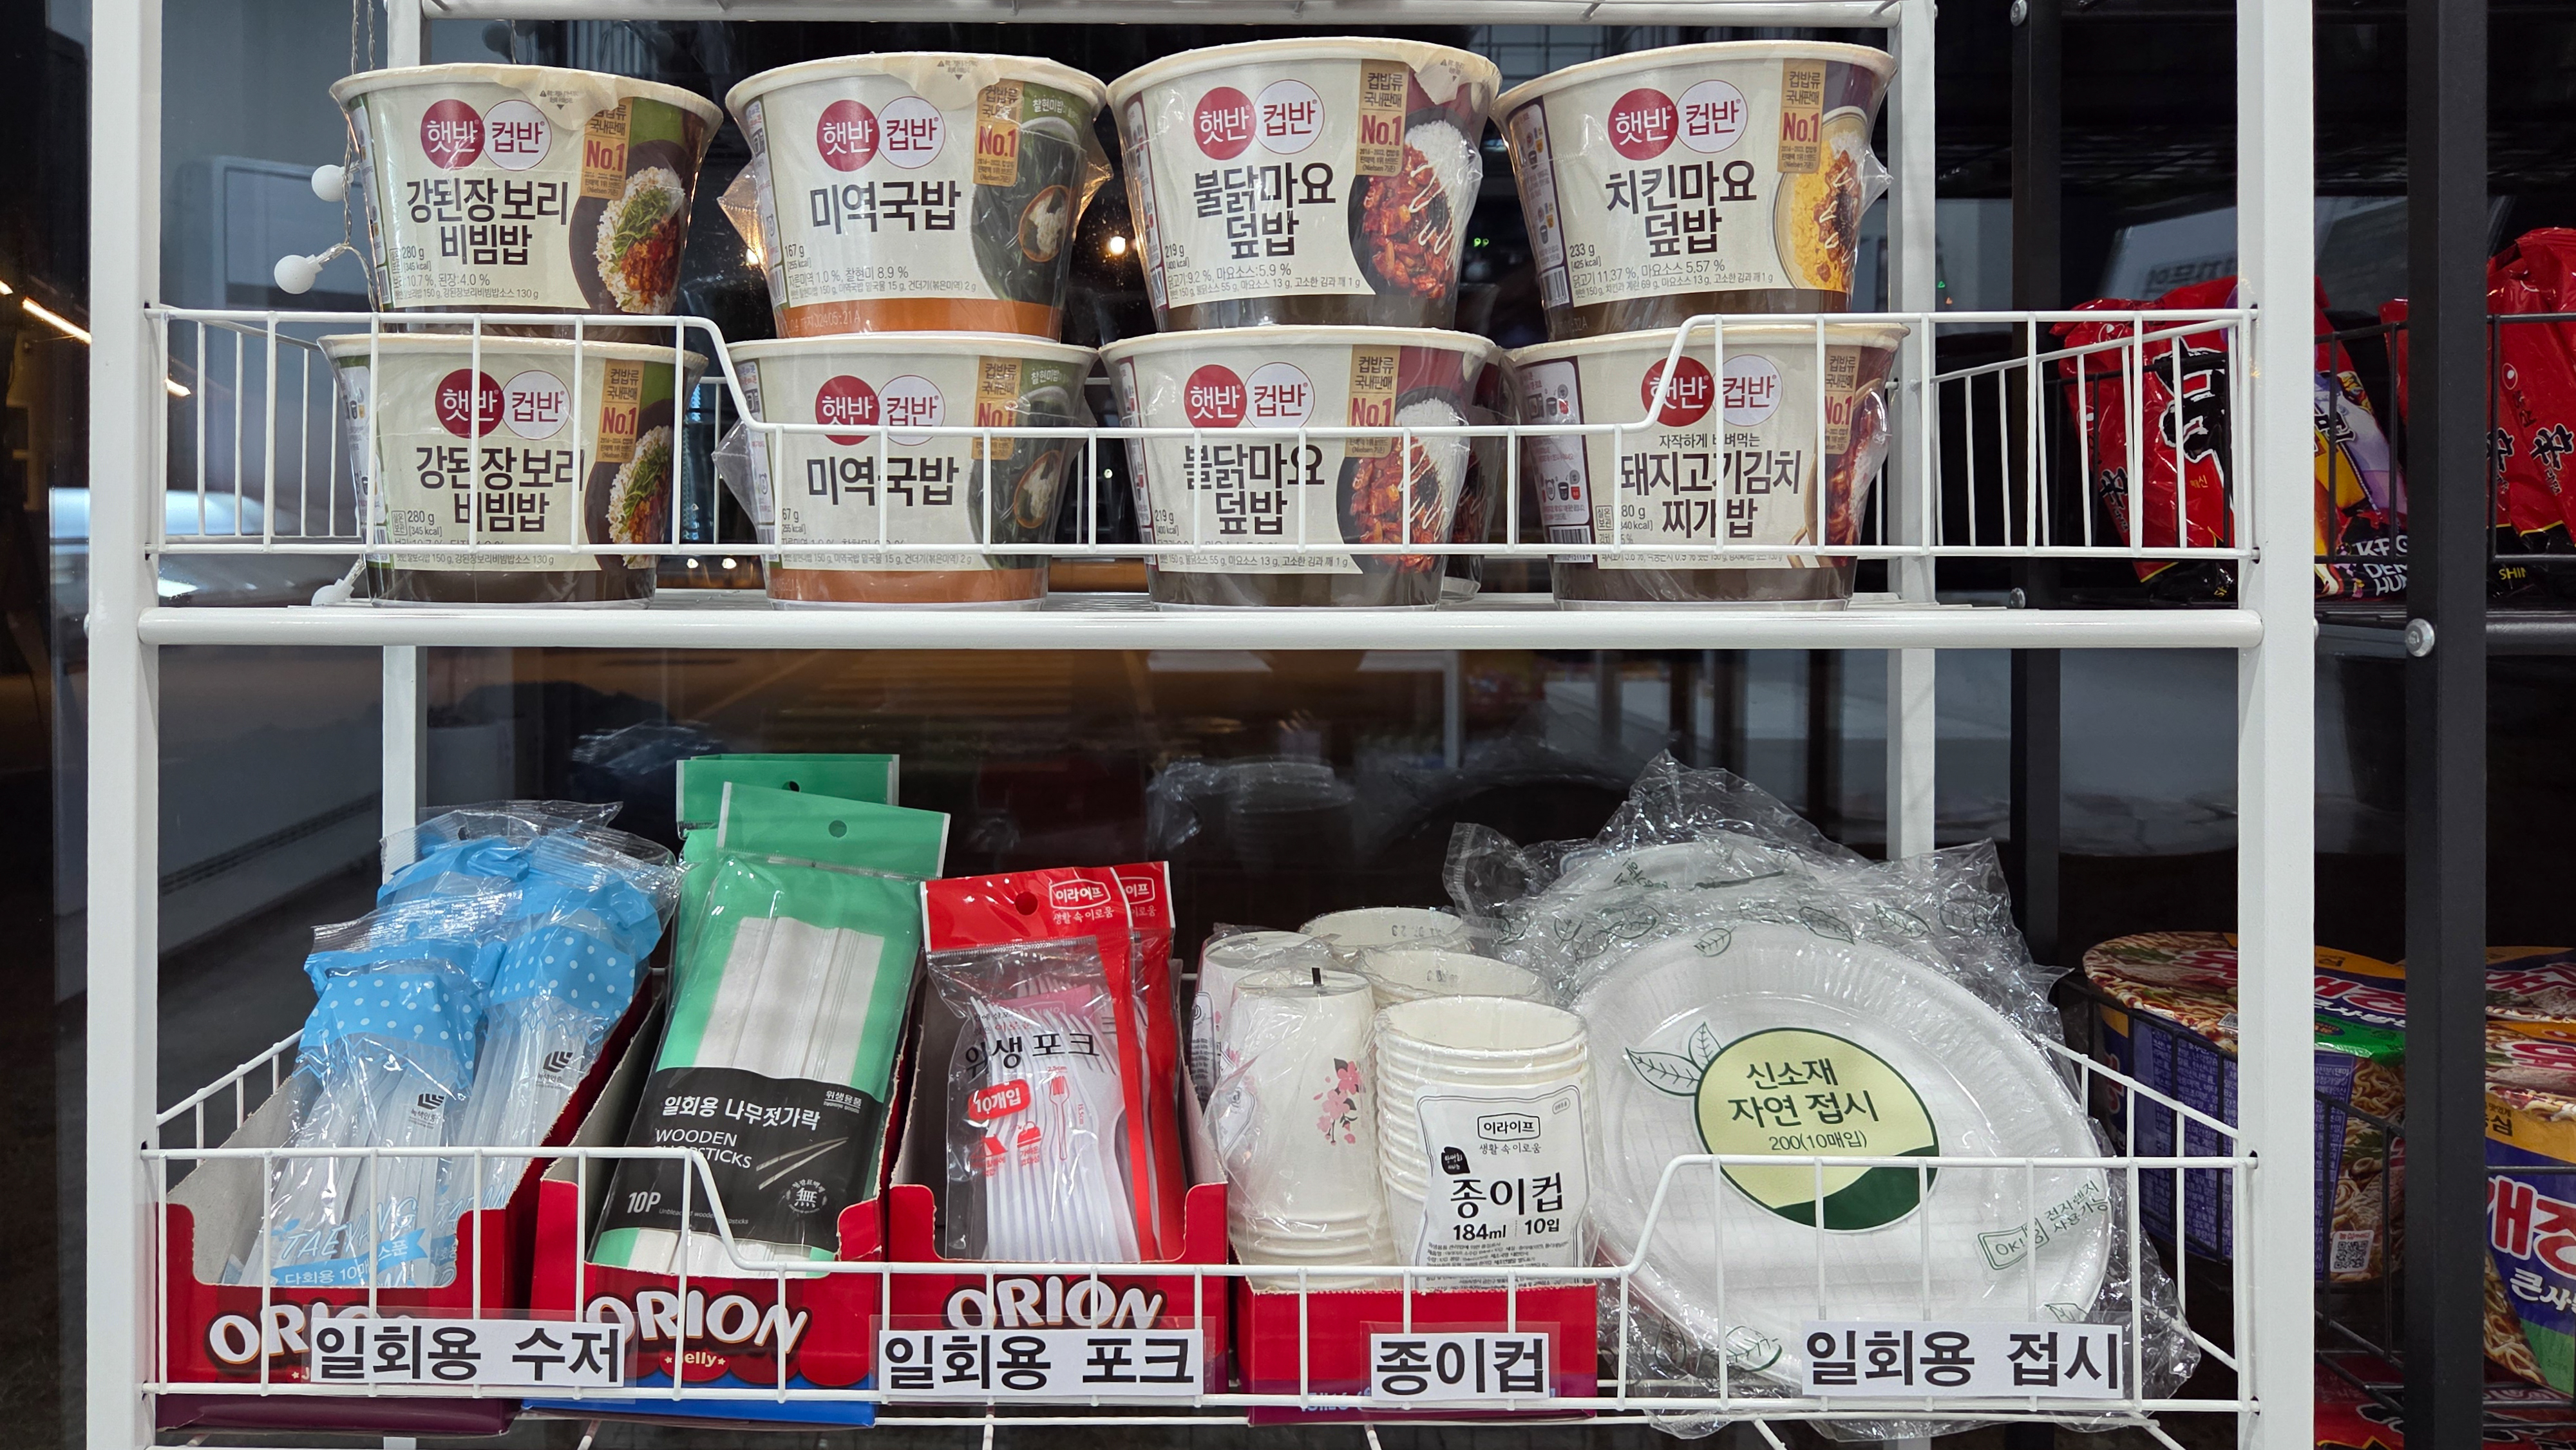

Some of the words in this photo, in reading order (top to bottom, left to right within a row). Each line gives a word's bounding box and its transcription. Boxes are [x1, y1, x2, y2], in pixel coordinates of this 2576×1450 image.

[1367, 73, 1403, 91] 컵밥류
[1789, 71, 1821, 89] 컵밥류
[1364, 91, 1402, 108] 국내판매
[1786, 90, 1819, 106] 국내판매
[589, 118, 626, 137] 국내판매
[1199, 110, 1249, 146] 햇반
[1264, 100, 1316, 137] 컵반
[1361, 115, 1402, 146] No.1
[1615, 109, 1671, 146] 햇반
[1685, 99, 1739, 137] 컵반
[1783, 112, 1819, 142] No.1
[426, 120, 476, 154] 햇반
[491, 122, 542, 153] 컵반
[823, 120, 873, 155] 햇반
[886, 118, 937, 152] 컵반
[978, 126, 1017, 158] No.1
[586, 140, 625, 172] No.1
[1194, 162, 1336, 219] 불닭마요
[1605, 160, 1757, 214] 치킨마요
[810, 180, 961, 234] 미역국밥
[1226, 211, 1300, 259] 덮밥
[1645, 208, 1722, 258] 덮밥
[402, 246, 417, 259] 280
[442, 225, 533, 265] 비빔밥
[784, 244, 797, 258] 167
[1165, 245, 1178, 258] 219
[1569, 244, 1587, 258] 233
[416, 260, 431, 272] kcal]
[815, 271, 829, 284] 1.0
[845, 267, 875, 283] 찰현미
[877, 267, 895, 279] 8.9
[1217, 264, 1276, 280] 마요소스:5.9
[1571, 260, 1584, 272] [425
[1585, 258, 1602, 268] kcal]
[1598, 269, 1623, 283] 11.37
[1642, 263, 1683, 278] 마요소스
[1686, 260, 1710, 274] 5.57
[438, 274, 477, 286] 된장:4.0
[887, 281, 898, 290] 15
[1221, 282, 1231, 292] 55
[1241, 280, 1270, 289] 마요소스
[1273, 279, 1283, 288] 13
[1294, 277, 1318, 287] 고소한
[1642, 279, 1651, 290] 69
[1662, 276, 1691, 288] 마요소스
[1693, 275, 1703, 285] 13
[1714, 274, 1736, 284] 고소한
[444, 288, 515, 299] 강된장보리비빔밥소스
[516, 289, 531, 298] 130
[985, 363, 1016, 380] 컵밥류
[1359, 356, 1394, 374] 컵밥류
[1830, 355, 1855, 373] 컵밥류
[610, 369, 639, 386] 컵밥류
[1355, 375, 1392, 390] 국내판매
[1825, 374, 1854, 388] 국내판매
[607, 386, 638, 400] 국내판매
[1190, 386, 1238, 419] 햇반
[1255, 384, 1306, 417] 컵반
[1649, 377, 1707, 410] 햇반
[1723, 375, 1774, 409] 컵반
[443, 388, 497, 421] 햇반
[511, 390, 562, 422] 컵반
[822, 395, 873, 425] 햇반
[887, 396, 937, 426] 컵반
[1351, 397, 1392, 426] No.1
[1825, 395, 1852, 425] No.1
[602, 407, 636, 435] No.1
[1659, 433, 1707, 449] 자작하게
[1183, 444, 1325, 491] 불닭마요
[1621, 450, 1802, 496] 돼지고기김치
[807, 456, 960, 506] 미역국밥
[408, 511, 425, 522] 280
[455, 493, 549, 532] 비빔밥
[1155, 509, 1167, 522] 219
[1215, 491, 1288, 534] 덮밥
[408, 527, 423, 537] [345
[424, 526, 442, 537] kcal]
[1633, 520, 1653, 531] kcal]
[432, 554, 446, 563] 150
[455, 554, 530, 564] 강된장보리비빔밥소스
[533, 555, 547, 564] 130
[885, 555, 895, 563] 15
[1210, 556, 1219, 564] 55
[1229, 556, 1257, 566] 마요소스
[1260, 556, 1271, 566] 13
[1282, 556, 1305, 567] 고소한
[1308, 556, 1323, 567] 김과
[1056, 887, 1104, 903] 이라이프
[1053, 910, 1070, 925] 생활
[1074, 910, 1083, 923] 속
[1085, 906, 1115, 921] 이로움
[1032, 1033, 1100, 1056] 포크
[1747, 1058, 1839, 1090] 신소재
[826, 1090, 862, 1107] 위생용품
[974, 1088, 1021, 1113] 10개입
[1728, 1095, 1801, 1128] 자연
[1808, 1089, 1879, 1125] 접시
[662, 1095, 719, 1117] 일회용
[724, 1098, 821, 1131] 나무젓가락
[656, 1128, 738, 1147] WOODEN
[1484, 1120, 1535, 1135] 이라이프
[1480, 1143, 1499, 1155] 생활
[1501, 1144, 1511, 1154] 속
[1512, 1142, 1541, 1154] 이로움
[1768, 1129, 1867, 1153] 200(10매입)
[627, 1191, 661, 1214] 10P
[795, 1187, 818, 1208] 無
[1450, 1172, 1563, 1219] 종이컵
[2044, 1180, 2099, 1221] 전자렌지
[2053, 1198, 2108, 1232] 사용가능
[1453, 1223, 1506, 1241] 184ml
[1524, 1218, 1560, 1236] 10입
[1995, 1237, 2026, 1256] OK!
[285, 1269, 335, 1285] 다회용
[378, 1239, 409, 1261] 스푼
[947, 1276, 1162, 1330] ORION
[586, 1290, 808, 1354] ORION
[316, 1325, 482, 1382] 일회용
[512, 1327, 618, 1382] 수저
[684, 1351, 717, 1368] elly
[885, 1335, 1051, 1391] 일회용
[1083, 1338, 1194, 1384] 포크
[1806, 1330, 1975, 1388] 일회용
[2007, 1331, 2119, 1390] 접시
[1376, 1338, 1544, 1395] 종이컵
